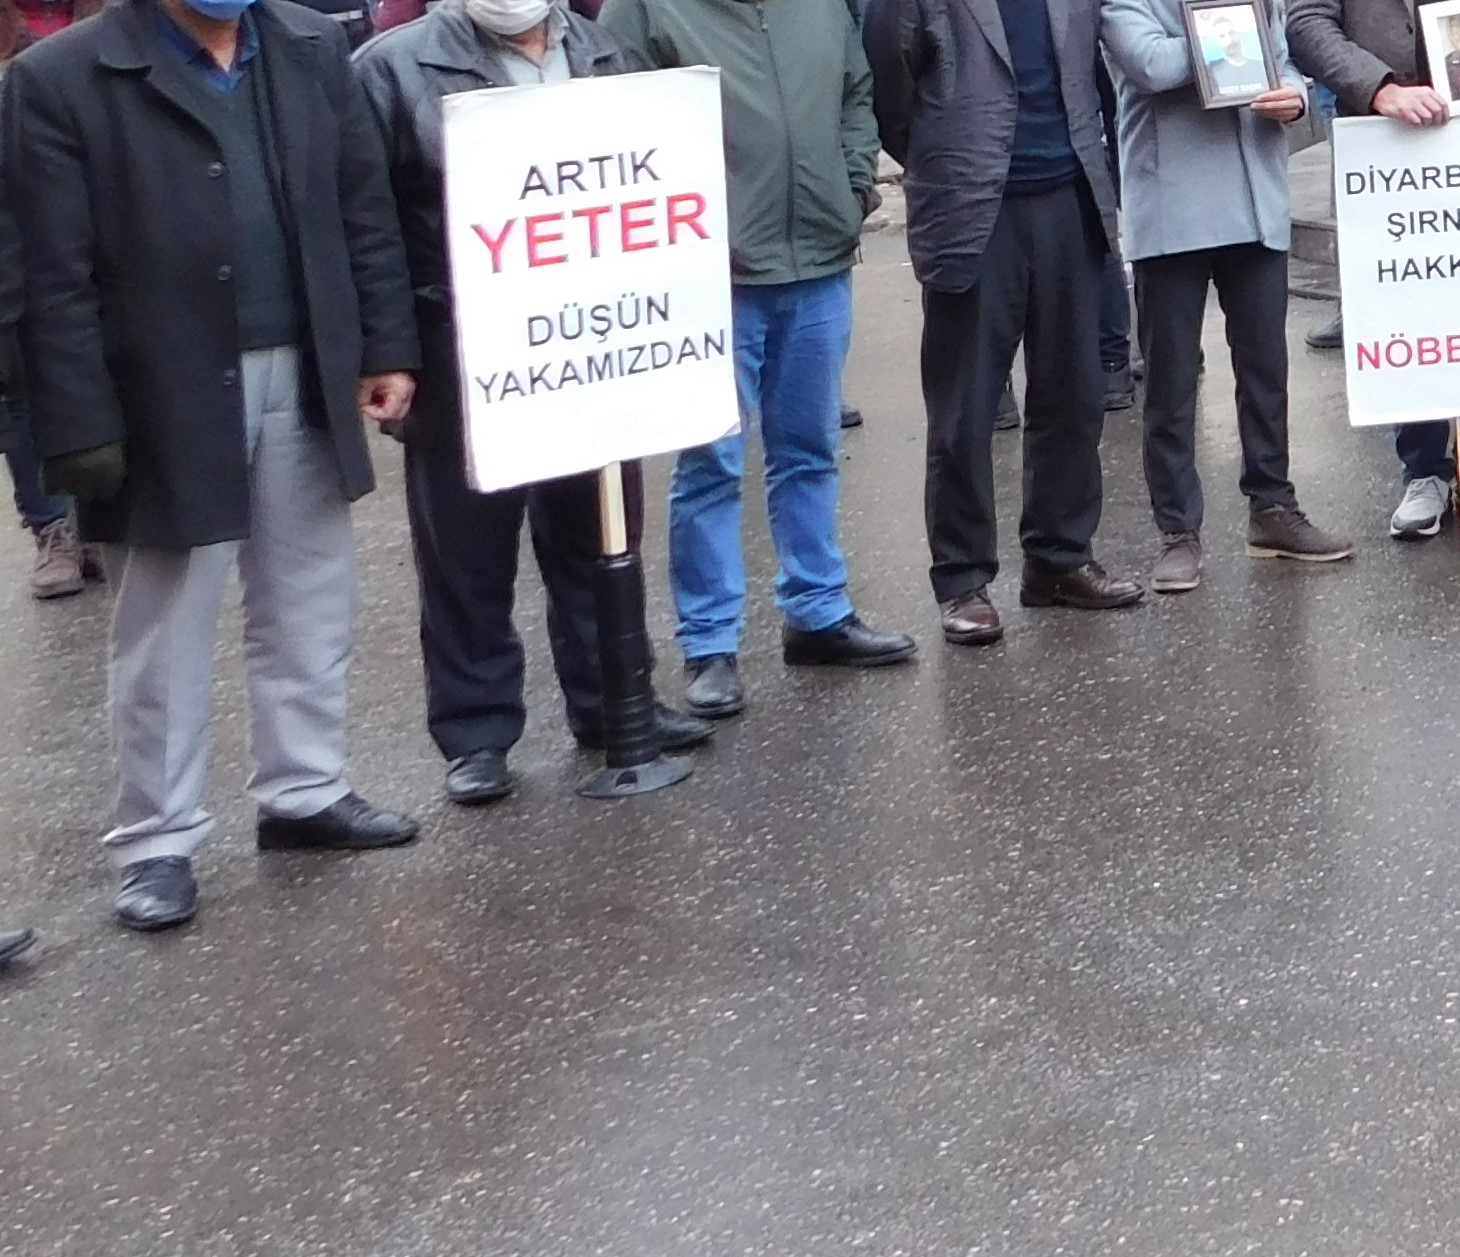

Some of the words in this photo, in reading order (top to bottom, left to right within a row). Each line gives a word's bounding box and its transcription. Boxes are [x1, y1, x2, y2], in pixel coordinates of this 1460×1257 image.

[519, 148, 661, 200] ARTIK
[471, 192, 711, 273] YETER
[528, 292, 671, 347] DÜŞÜN
[475, 328, 726, 405] YAKAMIZDAN
